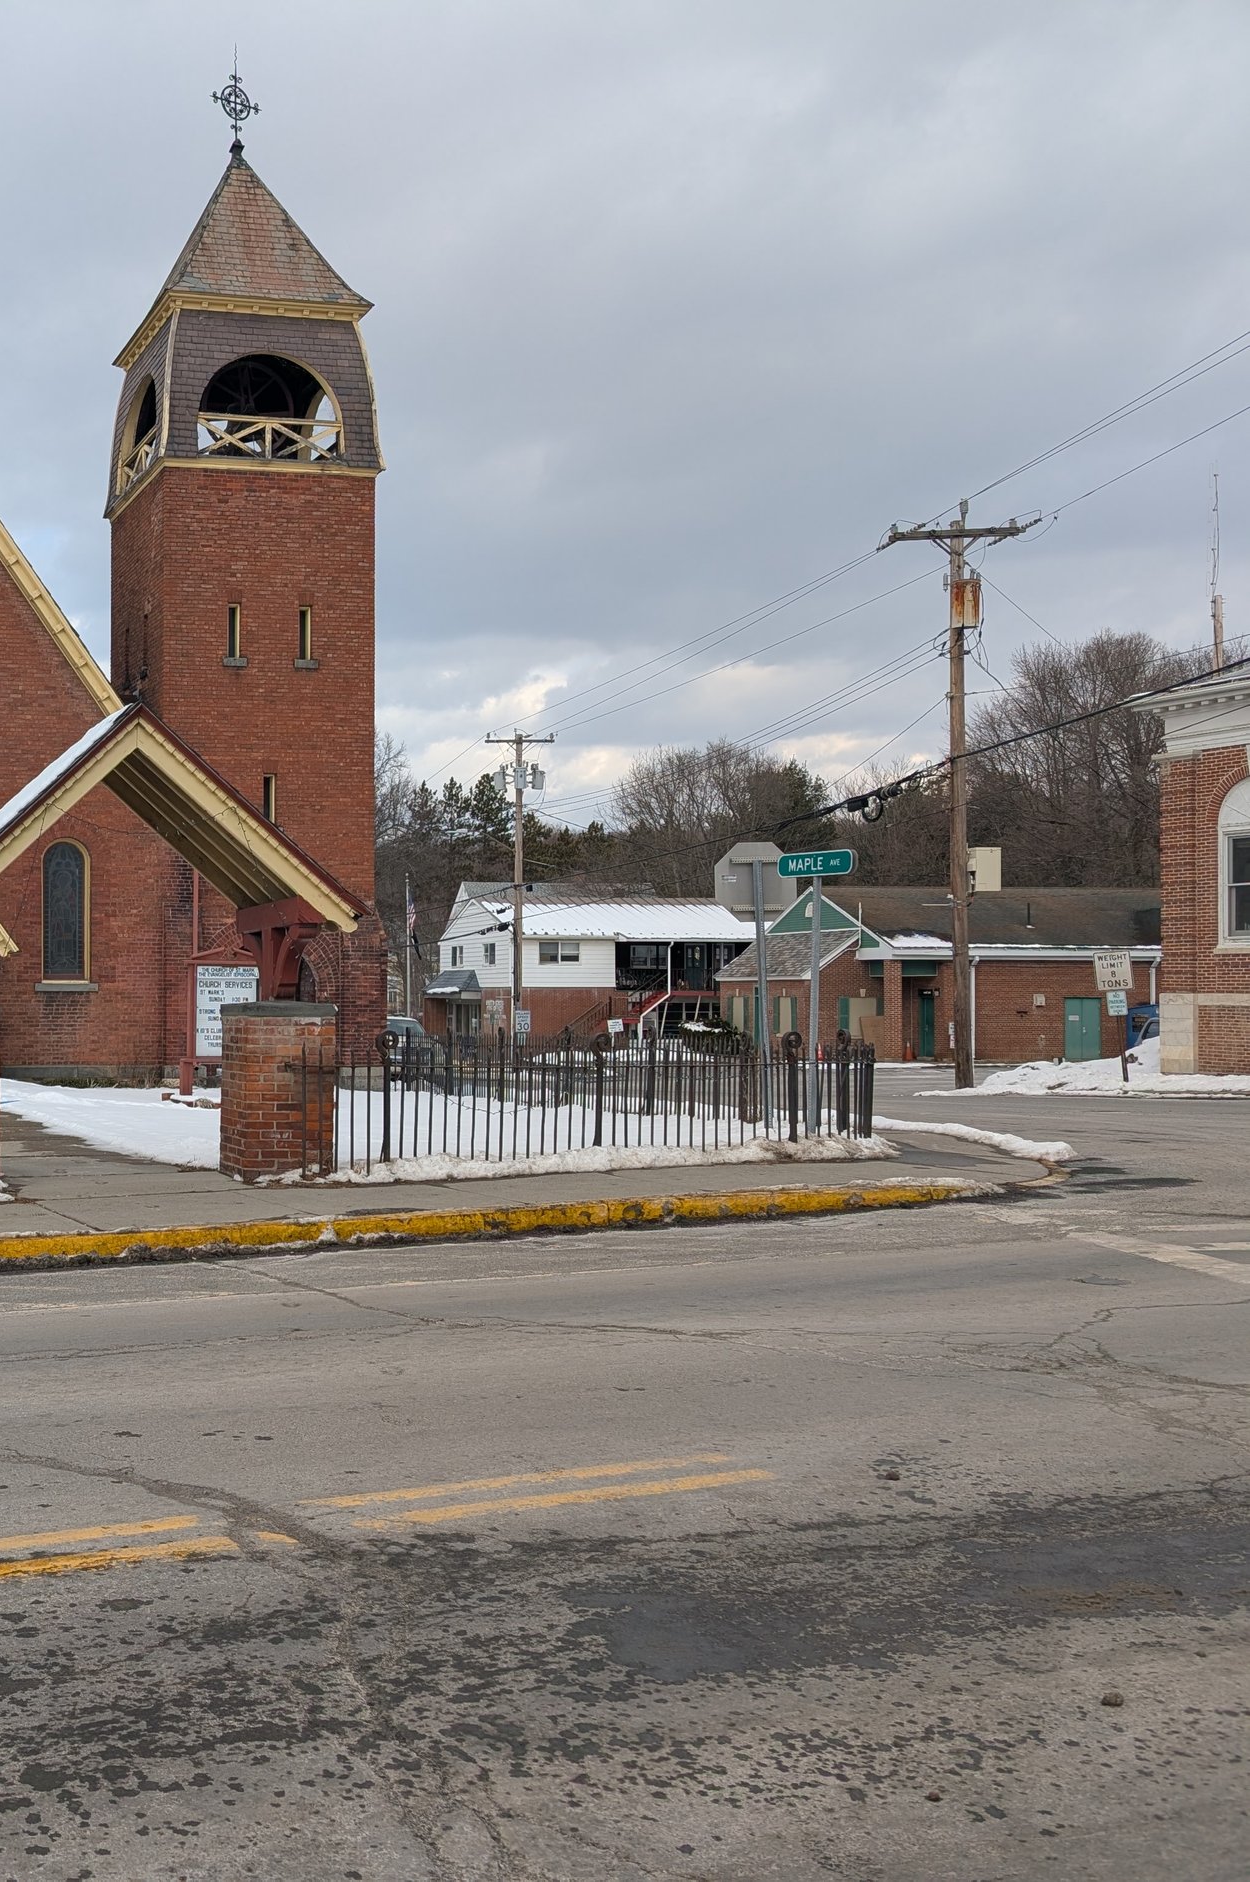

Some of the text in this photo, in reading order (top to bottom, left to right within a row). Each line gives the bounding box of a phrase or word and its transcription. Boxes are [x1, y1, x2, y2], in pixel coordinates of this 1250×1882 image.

[788, 857, 841, 872] MAPLE AVE
[1097, 954, 1127, 962] WEIGHT
[1110, 970, 1117, 978] 8
[224, 981, 253, 989] SERVICES
[1101, 979, 1129, 988] TONS
[517, 1023, 529, 1031] 30
